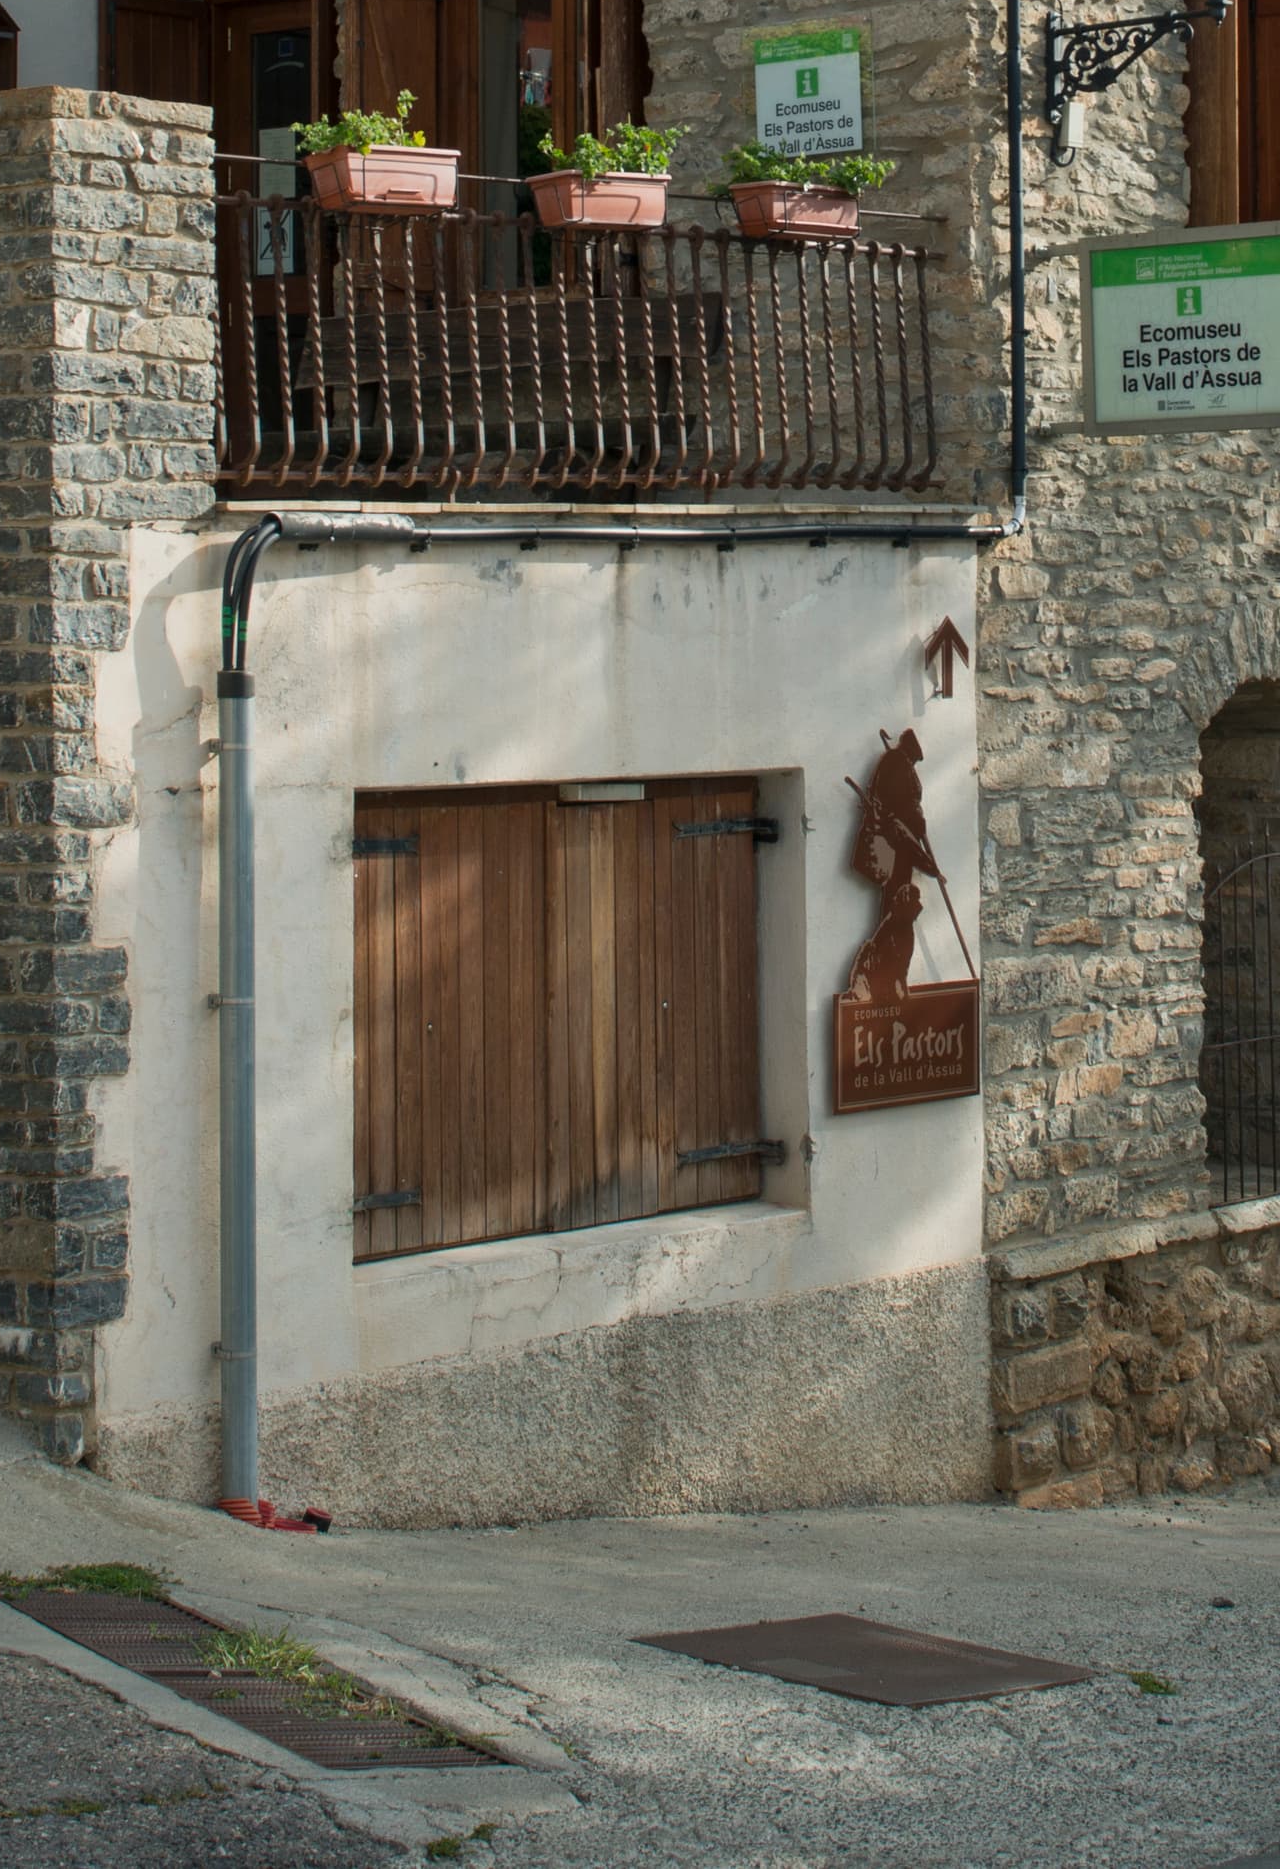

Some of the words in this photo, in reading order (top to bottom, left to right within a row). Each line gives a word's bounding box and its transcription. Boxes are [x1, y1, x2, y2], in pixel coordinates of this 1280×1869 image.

[775, 99, 841, 117] Ecomuseu
[764, 123, 783, 137] Els
[786, 119, 834, 134] Pastors
[837, 114, 854, 129] de
[1140, 322, 1241, 343] Ecomuseu
[1122, 349, 1152, 368] Els
[1158, 346, 1231, 366] Pastors
[1237, 342, 1261, 362] de
[1122, 374, 1138, 393] la
[1142, 371, 1176, 392] Vall
[854, 1006, 902, 1021] ECOMUSEU
[854, 1026, 884, 1068] Els
[891, 1021, 964, 1064] Pastors
[854, 1074, 869, 1088] de
[874, 1071, 885, 1086] la
[889, 1068, 913, 1083] Vall
